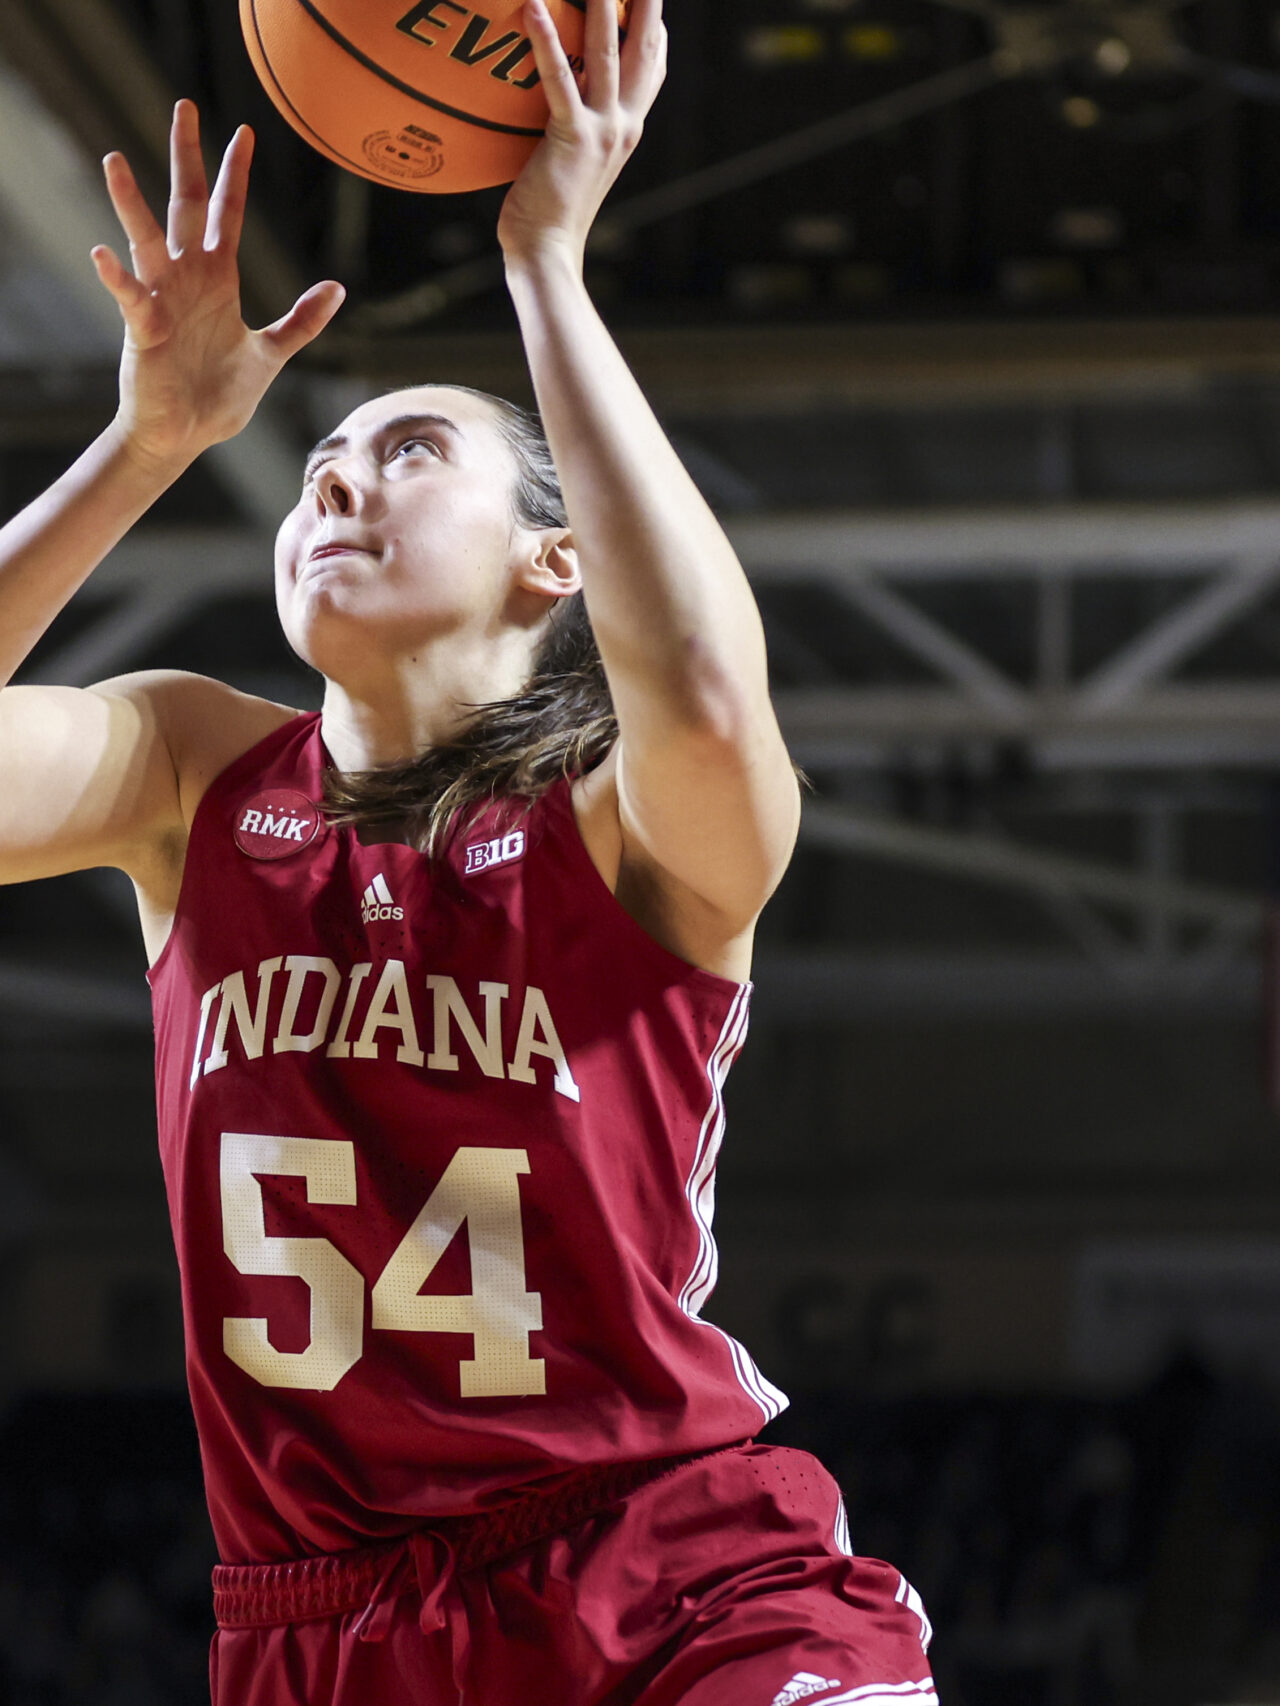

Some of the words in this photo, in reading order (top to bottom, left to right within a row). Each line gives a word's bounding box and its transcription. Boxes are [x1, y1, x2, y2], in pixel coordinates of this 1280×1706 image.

[238, 808, 311, 842] RMK
[189, 954, 581, 1103] INDIANA
[220, 1132, 547, 1398] 54
